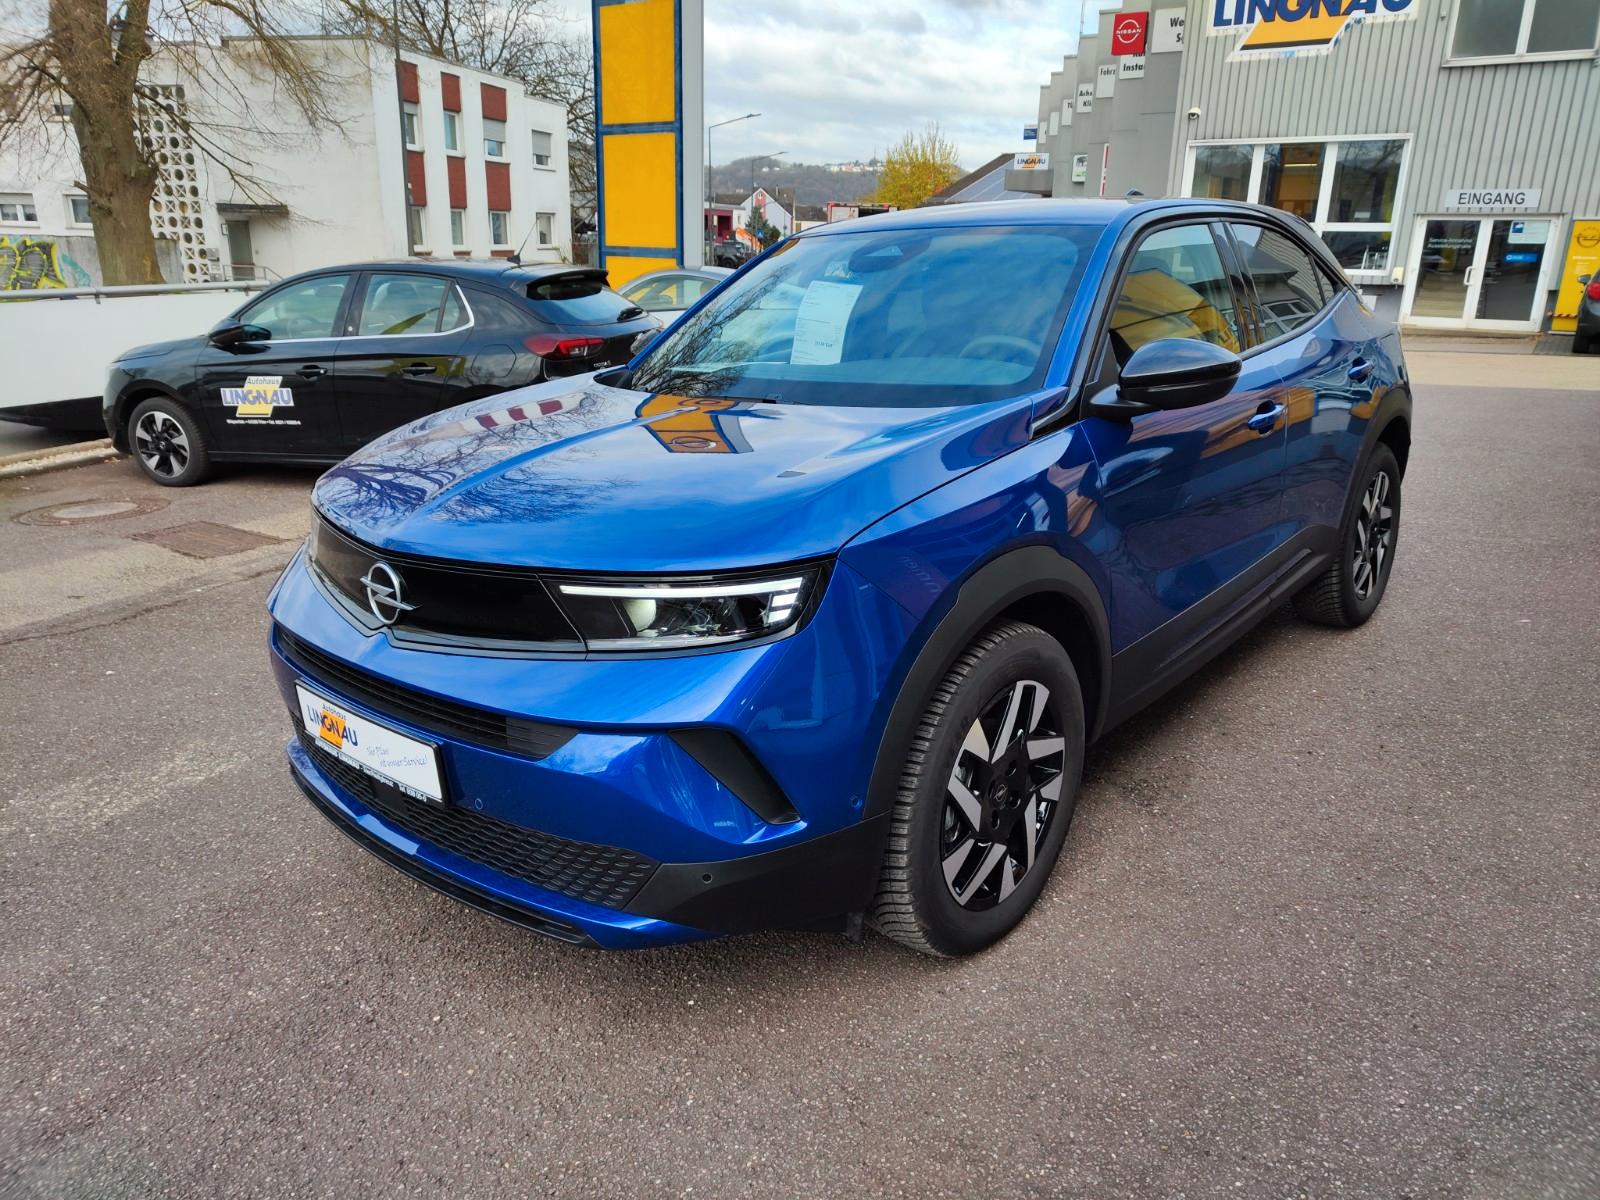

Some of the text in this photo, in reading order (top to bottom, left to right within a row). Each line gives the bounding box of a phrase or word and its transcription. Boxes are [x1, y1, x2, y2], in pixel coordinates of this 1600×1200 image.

[1213, 0, 1412, 27] LING
[1123, 63, 1145, 72] Insta
[1458, 192, 1526, 205] EINGANG
[223, 390, 292, 405] LINGNAU
[307, 704, 358, 746] LINGNAU
